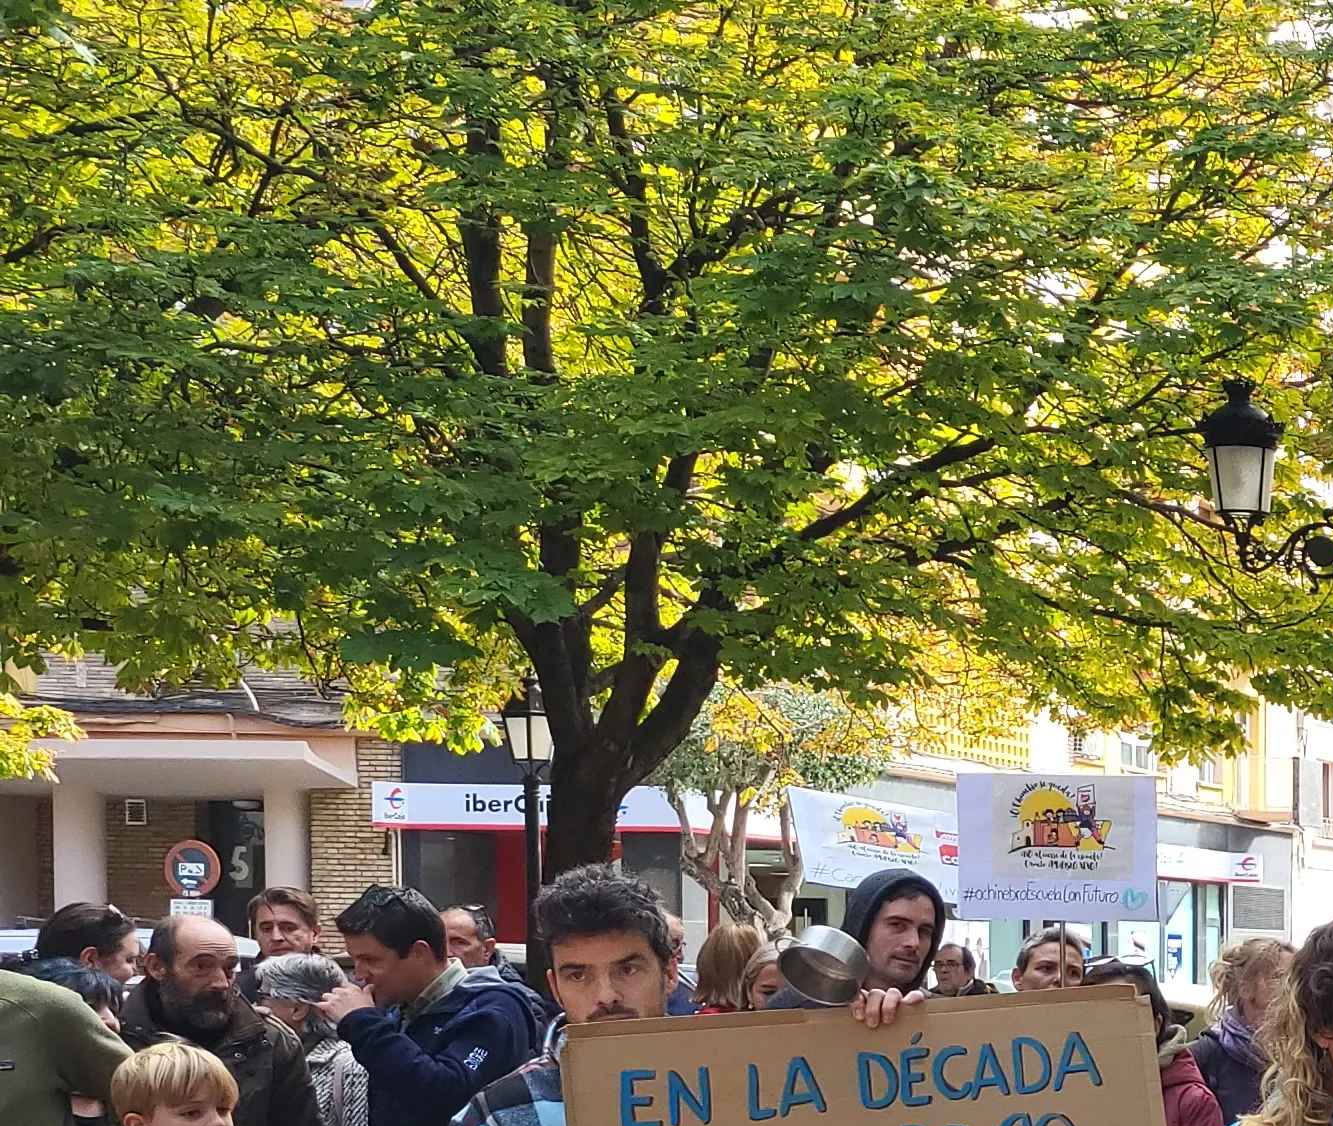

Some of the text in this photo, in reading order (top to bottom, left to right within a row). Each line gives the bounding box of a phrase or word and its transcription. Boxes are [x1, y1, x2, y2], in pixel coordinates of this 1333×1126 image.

[229, 845, 249, 880] 5
[747, 1056, 827, 1121] LA
[858, 1031, 1102, 1110] DÉCADA
